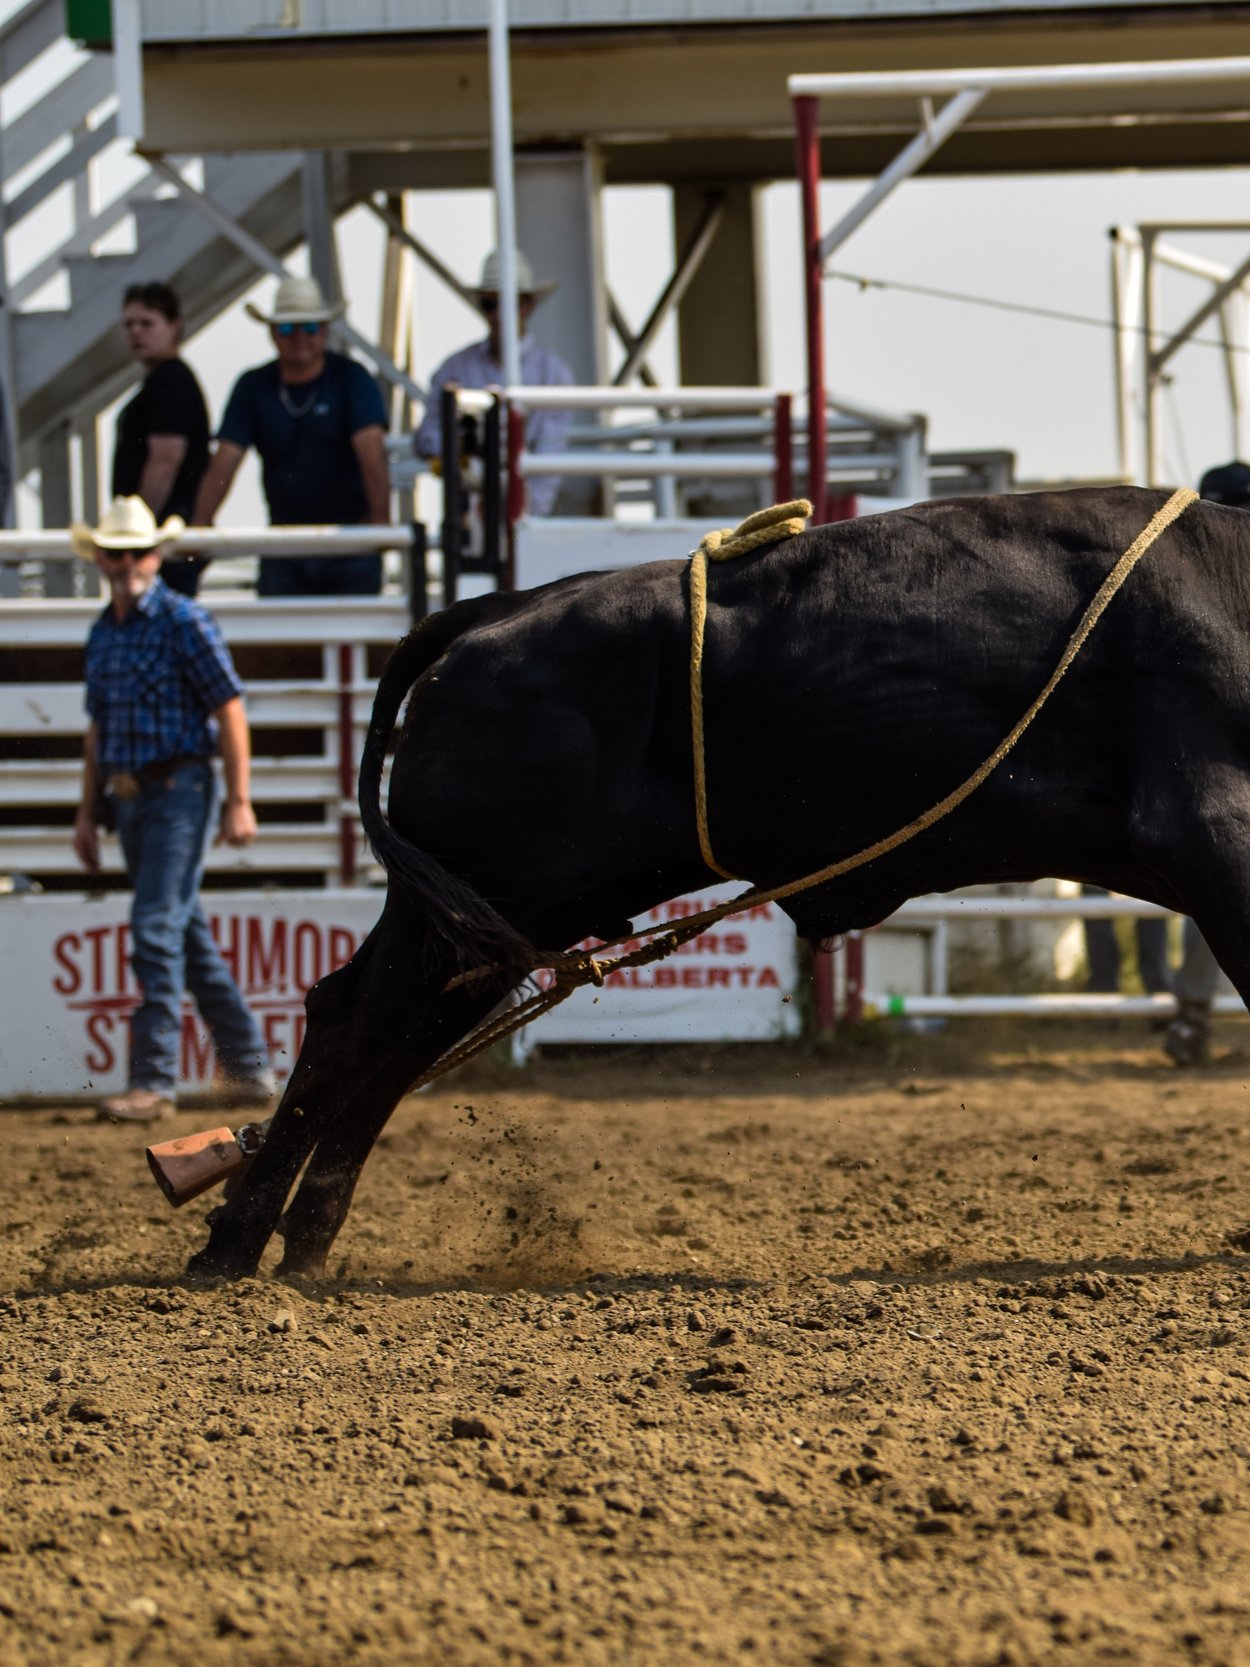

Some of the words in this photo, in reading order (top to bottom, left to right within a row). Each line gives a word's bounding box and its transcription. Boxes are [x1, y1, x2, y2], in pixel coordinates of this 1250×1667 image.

[649, 898, 773, 921] TRK
[53, 915, 369, 996] STRHMOR
[604, 967, 780, 990] ALBERTA
